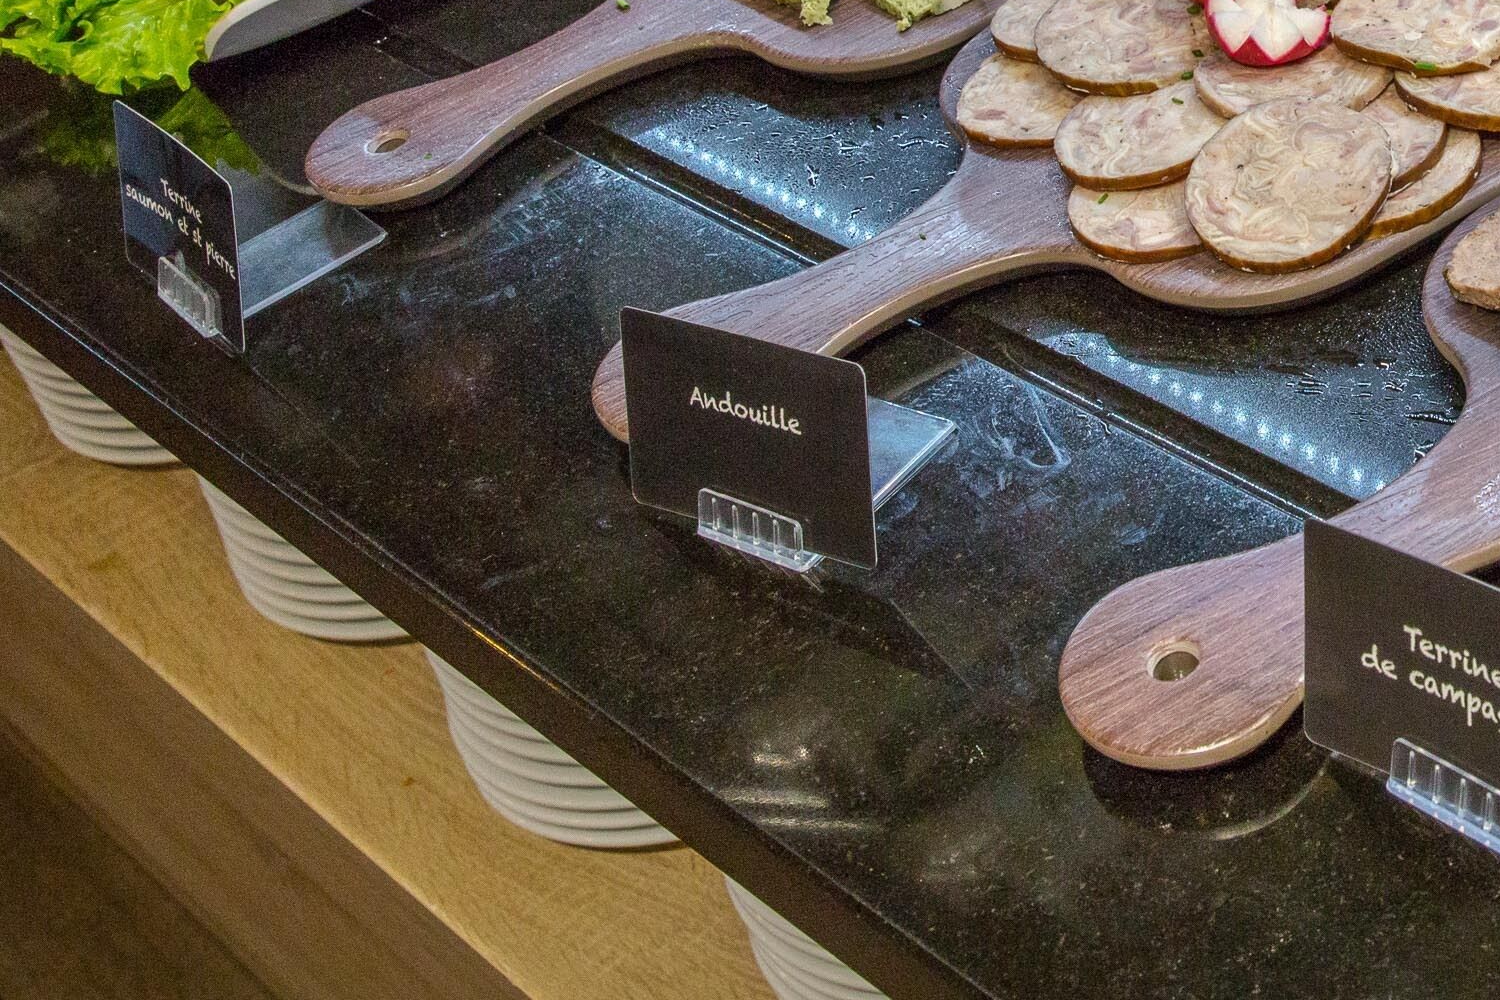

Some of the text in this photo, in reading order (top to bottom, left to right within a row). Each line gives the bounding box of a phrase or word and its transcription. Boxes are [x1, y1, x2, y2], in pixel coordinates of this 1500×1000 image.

[160, 178, 202, 224] Terrine
[126, 184, 236, 280] saumon et st pierre
[690, 386, 802, 436] Andouille
[1361, 644, 1398, 680] de
